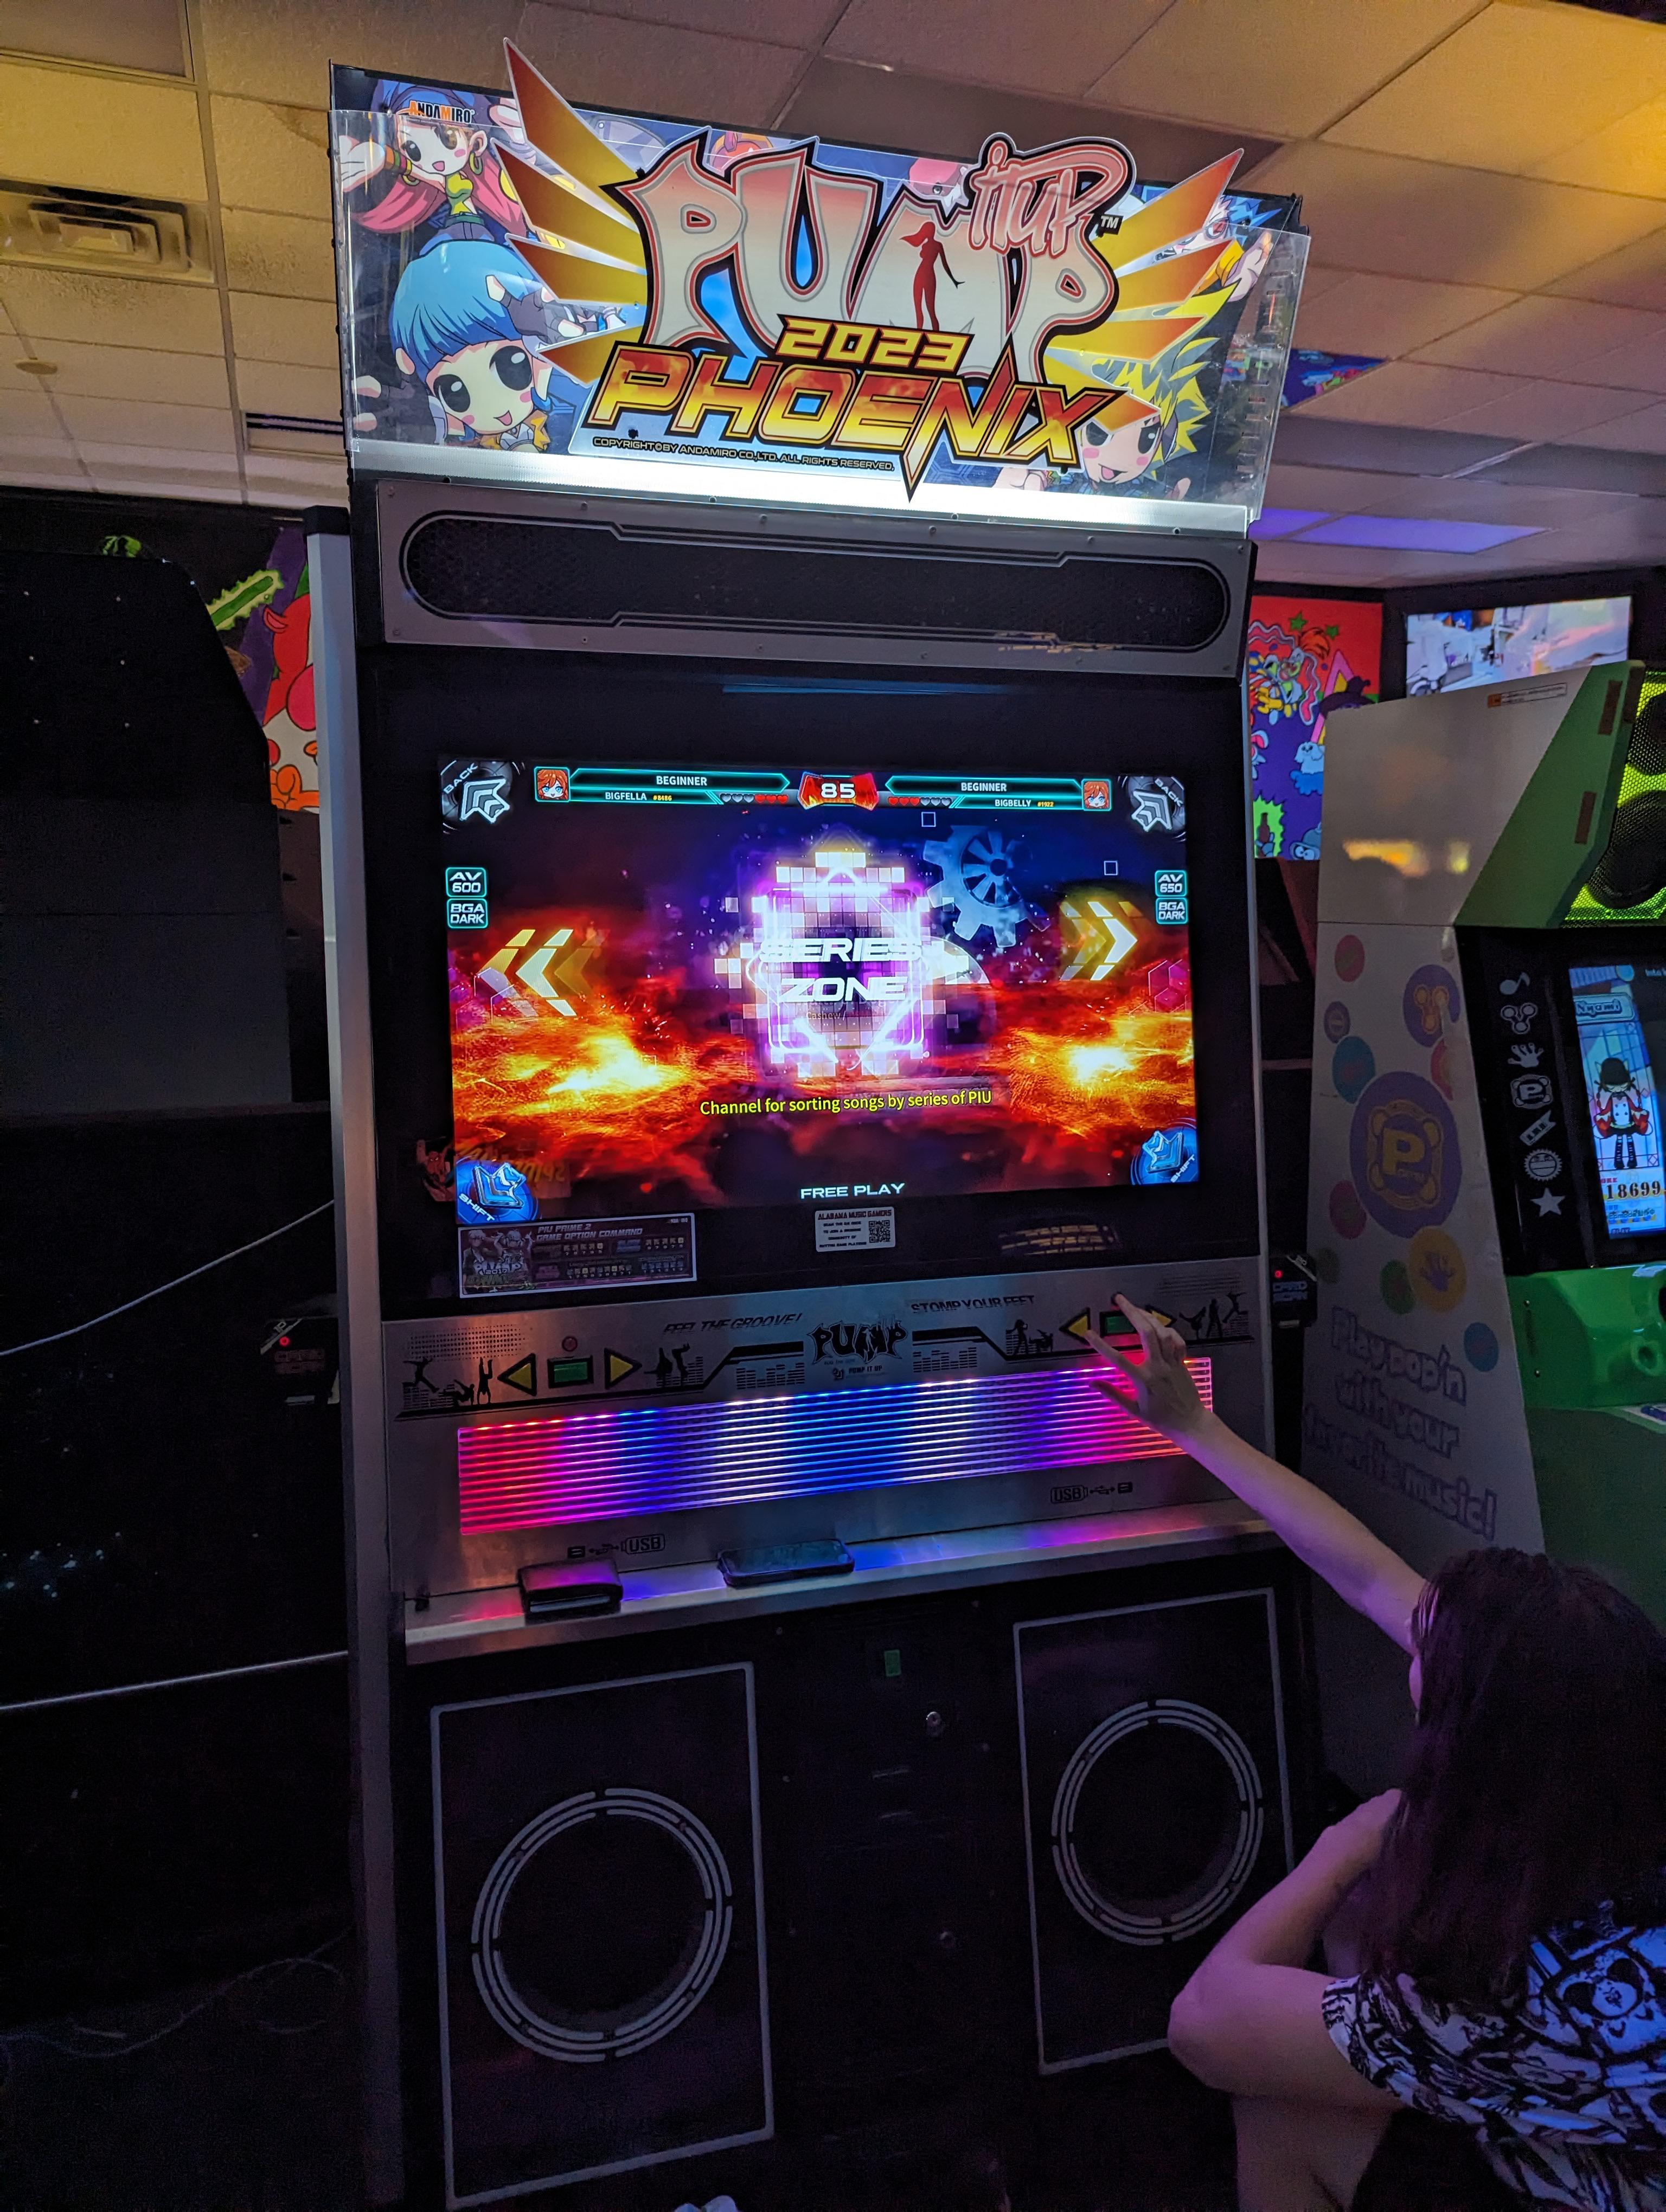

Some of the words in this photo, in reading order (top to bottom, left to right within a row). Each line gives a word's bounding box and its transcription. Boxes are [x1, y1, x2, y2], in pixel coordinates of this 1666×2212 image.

[617, 138, 1118, 381] PUMP
[777, 317, 970, 372] 2023
[587, 345, 1128, 502] PHOENIX
[679, 443, 737, 459] ANDAMIRO
[780, 454, 800, 464] ALL
[802, 456, 838, 467] RIGHTS
[444, 763, 478, 795] BACK
[656, 775, 708, 787] BEGINNER
[960, 782, 1008, 793] BEGINNER
[605, 791, 647, 801] BIGFELLA
[821, 782, 855, 800] 85
[1155, 777, 1183, 807] BACK
[995, 799, 1031, 807] BIGBELLY
[449, 872, 482, 881] AV
[1158, 874, 1183, 883] AV
[452, 882, 481, 893] 600
[1159, 883, 1183, 893] 650
[450, 903, 485, 913] BGA
[1158, 902, 1186, 911] BGA
[450, 913, 485, 924] DARK
[1158, 910, 1186, 921] DARK
[759, 937, 921, 962] SERIES
[780, 976, 908, 1002] ZONE
[700, 1098, 761, 1115] Channel
[765, 1098, 786, 1113] for
[789, 1096, 841, 1114] sorting
[843, 1096, 885, 1112] songs
[888, 1094, 905, 1111] by
[908, 1092, 949, 1107] series
[951, 1090, 966, 1105] of
[969, 1090, 992, 1104] PIU
[800, 1186, 849, 1199] FREE
[854, 1182, 905, 1197] PLAY
[1606, 1180, 1661, 1200] 18699
[459, 1193, 495, 1221] SHIFT
[536, 1232, 561, 1242] GAME
[564, 1231, 597, 1240] OPTION
[599, 1228, 643, 1238] COMMAND
[555, 1224, 583, 1232] PRIME
[911, 1300, 961, 1314] STOMP
[960, 1297, 1002, 1309] YOUR
[807, 1320, 907, 1365] PUMP
[1054, 1484, 1082, 1502] USB
[628, 1536, 662, 1552] USB
